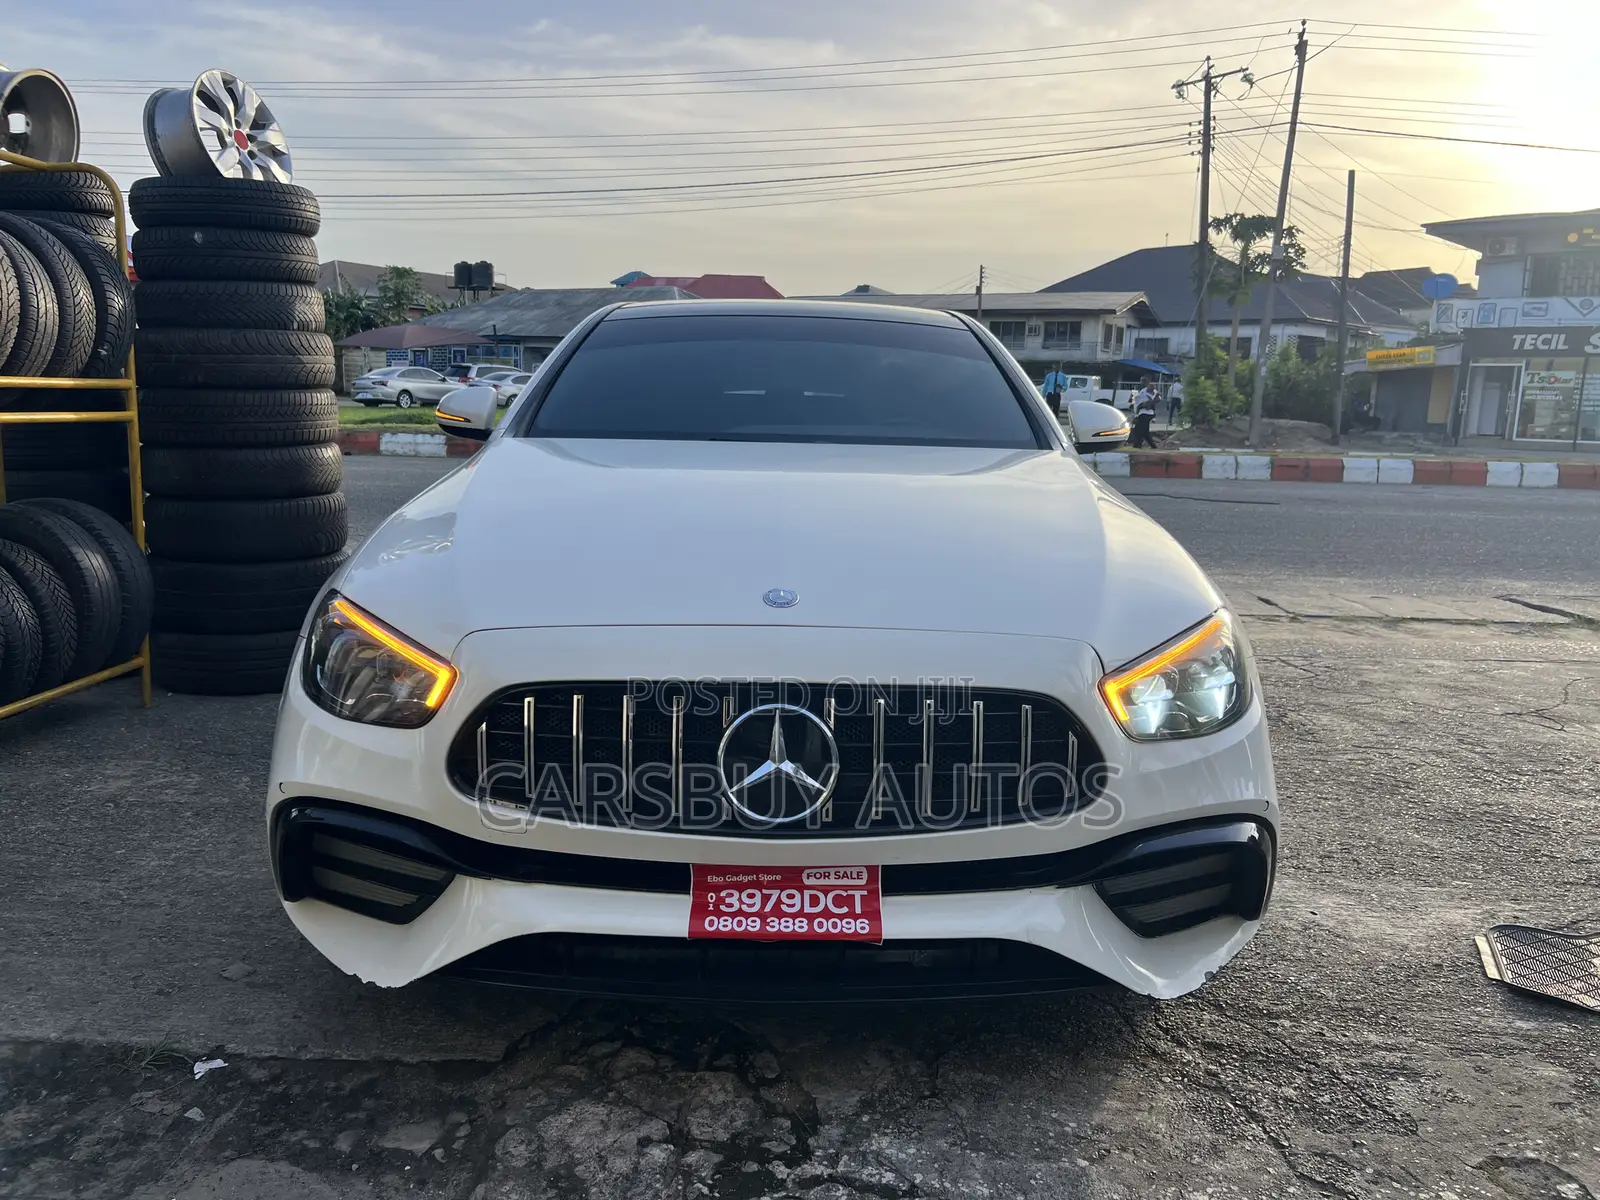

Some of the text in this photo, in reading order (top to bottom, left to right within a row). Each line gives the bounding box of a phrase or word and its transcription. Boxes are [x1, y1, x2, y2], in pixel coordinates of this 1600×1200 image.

[1512, 333, 1569, 351] TECIL
[707, 873, 782, 883] Ebo Gadget Store
[806, 870, 864, 881] FOR SALE
[719, 888, 868, 914] 3979DCT
[704, 916, 870, 934] 0809 388 0096
